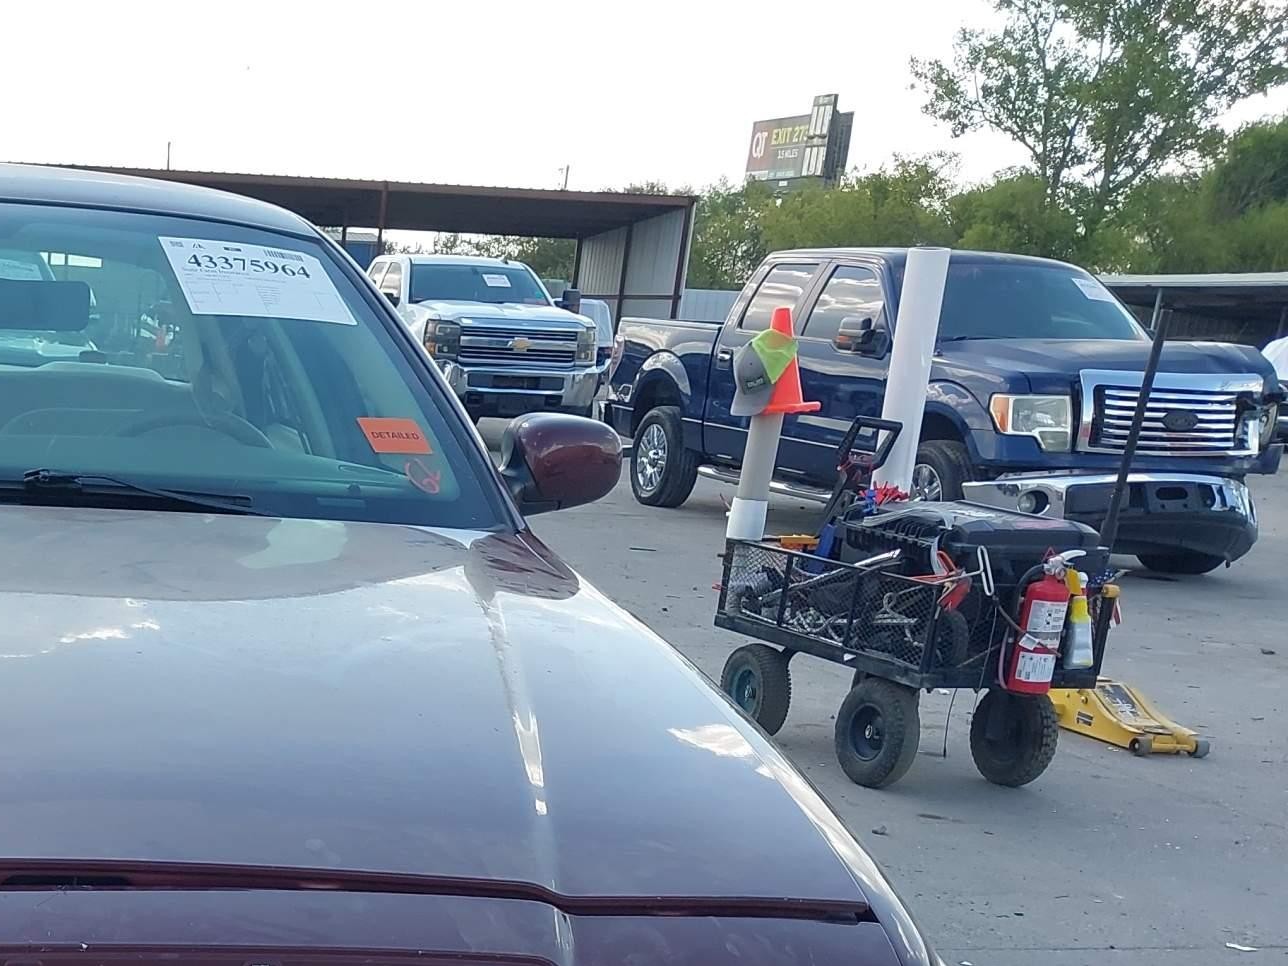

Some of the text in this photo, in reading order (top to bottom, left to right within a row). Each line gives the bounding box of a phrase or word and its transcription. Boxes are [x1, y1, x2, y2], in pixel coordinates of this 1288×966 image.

[752, 132, 769, 158] QT
[771, 127, 793, 146] EXIT
[187, 253, 311, 279] 43375964
[370, 431, 420, 440] DETAILED
